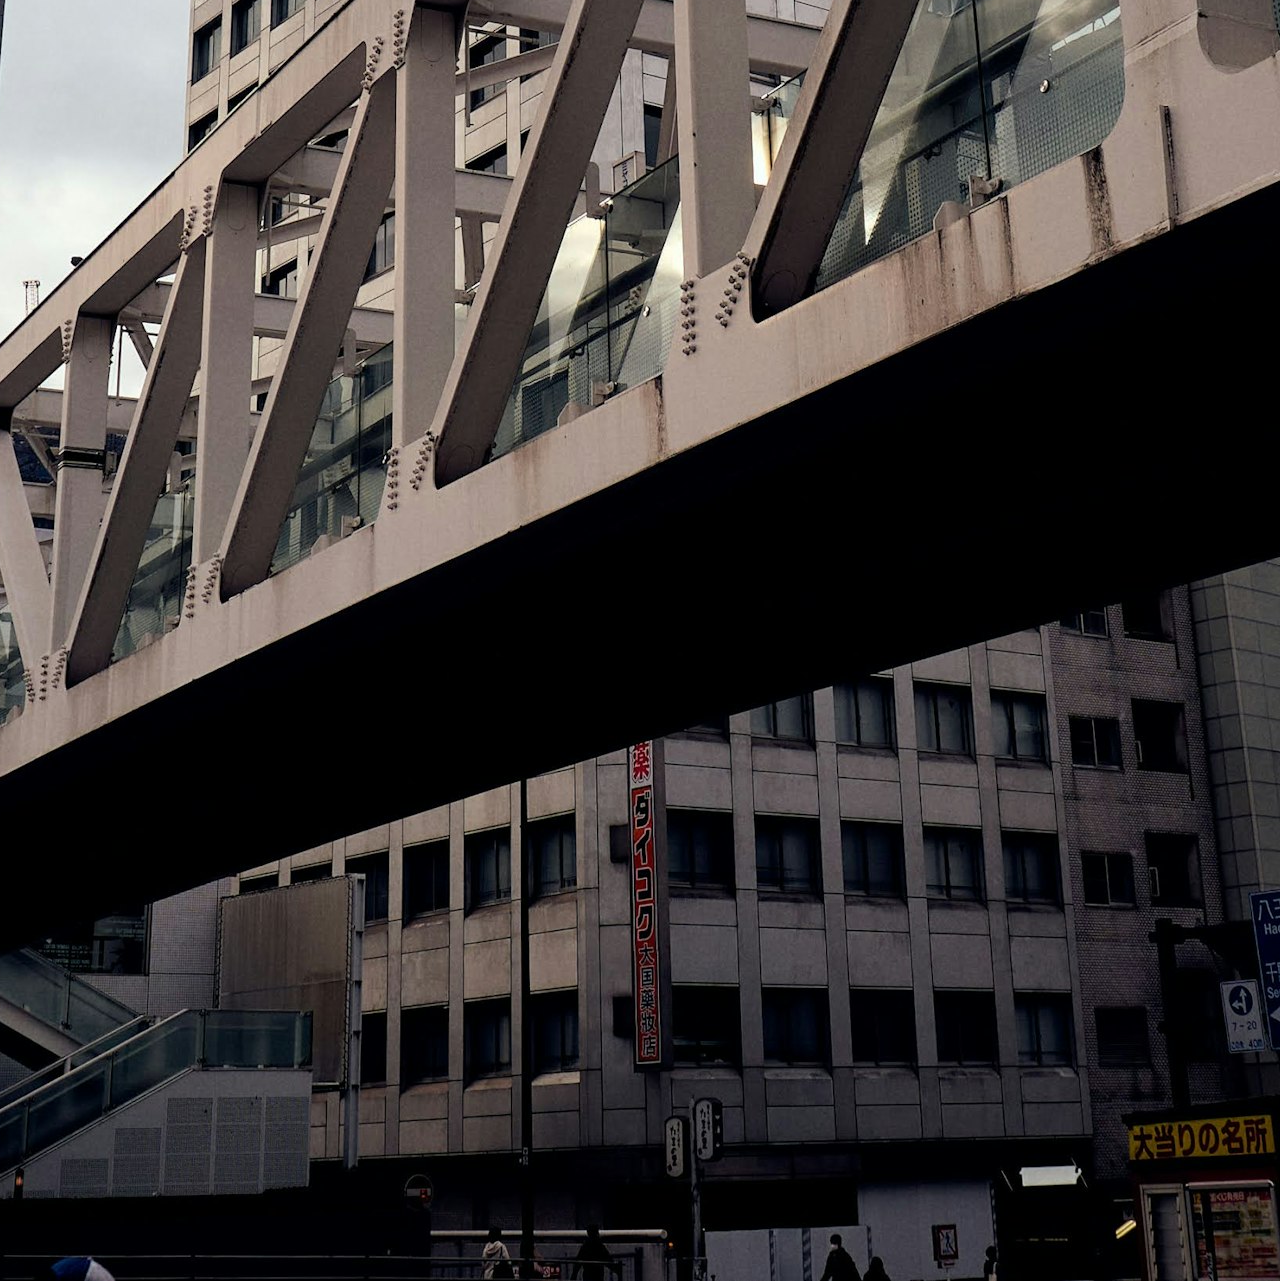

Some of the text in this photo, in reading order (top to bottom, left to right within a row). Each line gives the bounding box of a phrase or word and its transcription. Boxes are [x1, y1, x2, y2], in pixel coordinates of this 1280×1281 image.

[633, 788, 656, 942] ダイコク
[1133, 1117, 1268, 1160] 大当りの名所
